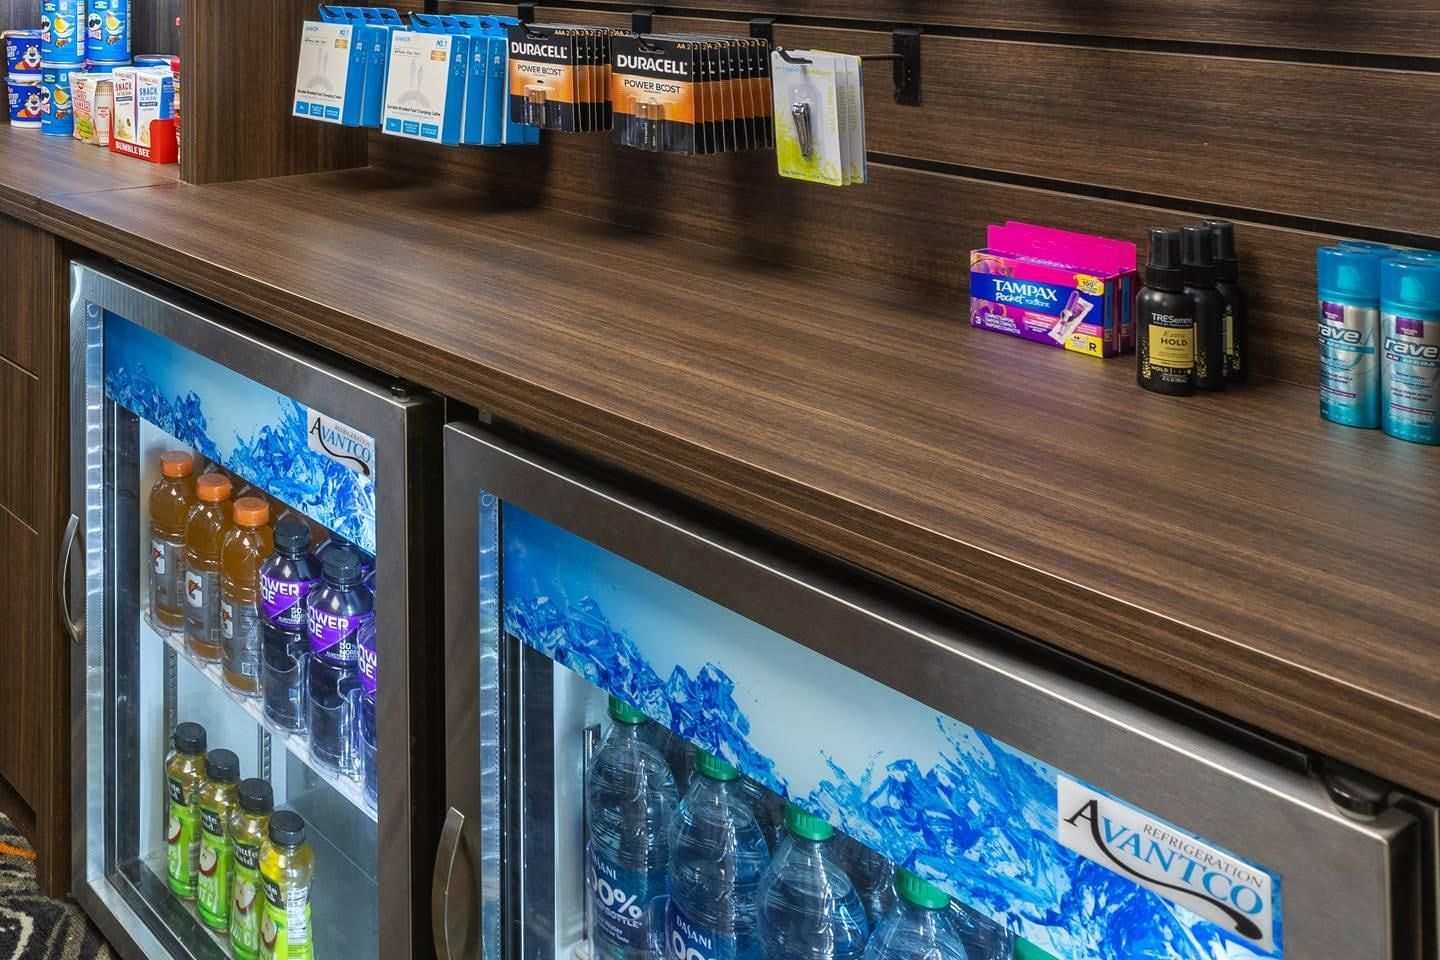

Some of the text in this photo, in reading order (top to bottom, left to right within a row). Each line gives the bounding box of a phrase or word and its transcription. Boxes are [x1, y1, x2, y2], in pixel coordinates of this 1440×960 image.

[511, 42, 568, 59] DURACELL
[517, 65, 561, 76] POWER BOOST
[616, 54, 688, 75] DURACELL
[115, 82, 132, 92] SNACK
[139, 87, 158, 96] SNACK
[624, 79, 681, 94] POWER BOOST
[417, 108, 432, 116] Charging
[115, 141, 151, 158] BUMBLE BEE
[993, 278, 1058, 302] TAMPAX
[995, 291, 1051, 309] Pocket radiant
[975, 316, 981, 324] 3
[1160, 338, 1188, 346] HOLD
[1318, 323, 1361, 344] rave
[1088, 342, 1097, 352] R
[1385, 338, 1438, 358] rave
[1387, 353, 1399, 361] 4X
[1151, 365, 1169, 373] HOLD
[310, 417, 371, 463] AVANTCO
[261, 575, 300, 597] OWER
[261, 587, 276, 605] DE
[307, 605, 349, 631] OWER
[307, 618, 323, 639] DE
[1063, 799, 1265, 917] AVANTCO
[1143, 824, 1263, 888] REFRIGERATION
[676, 915, 713, 950] DASANI
